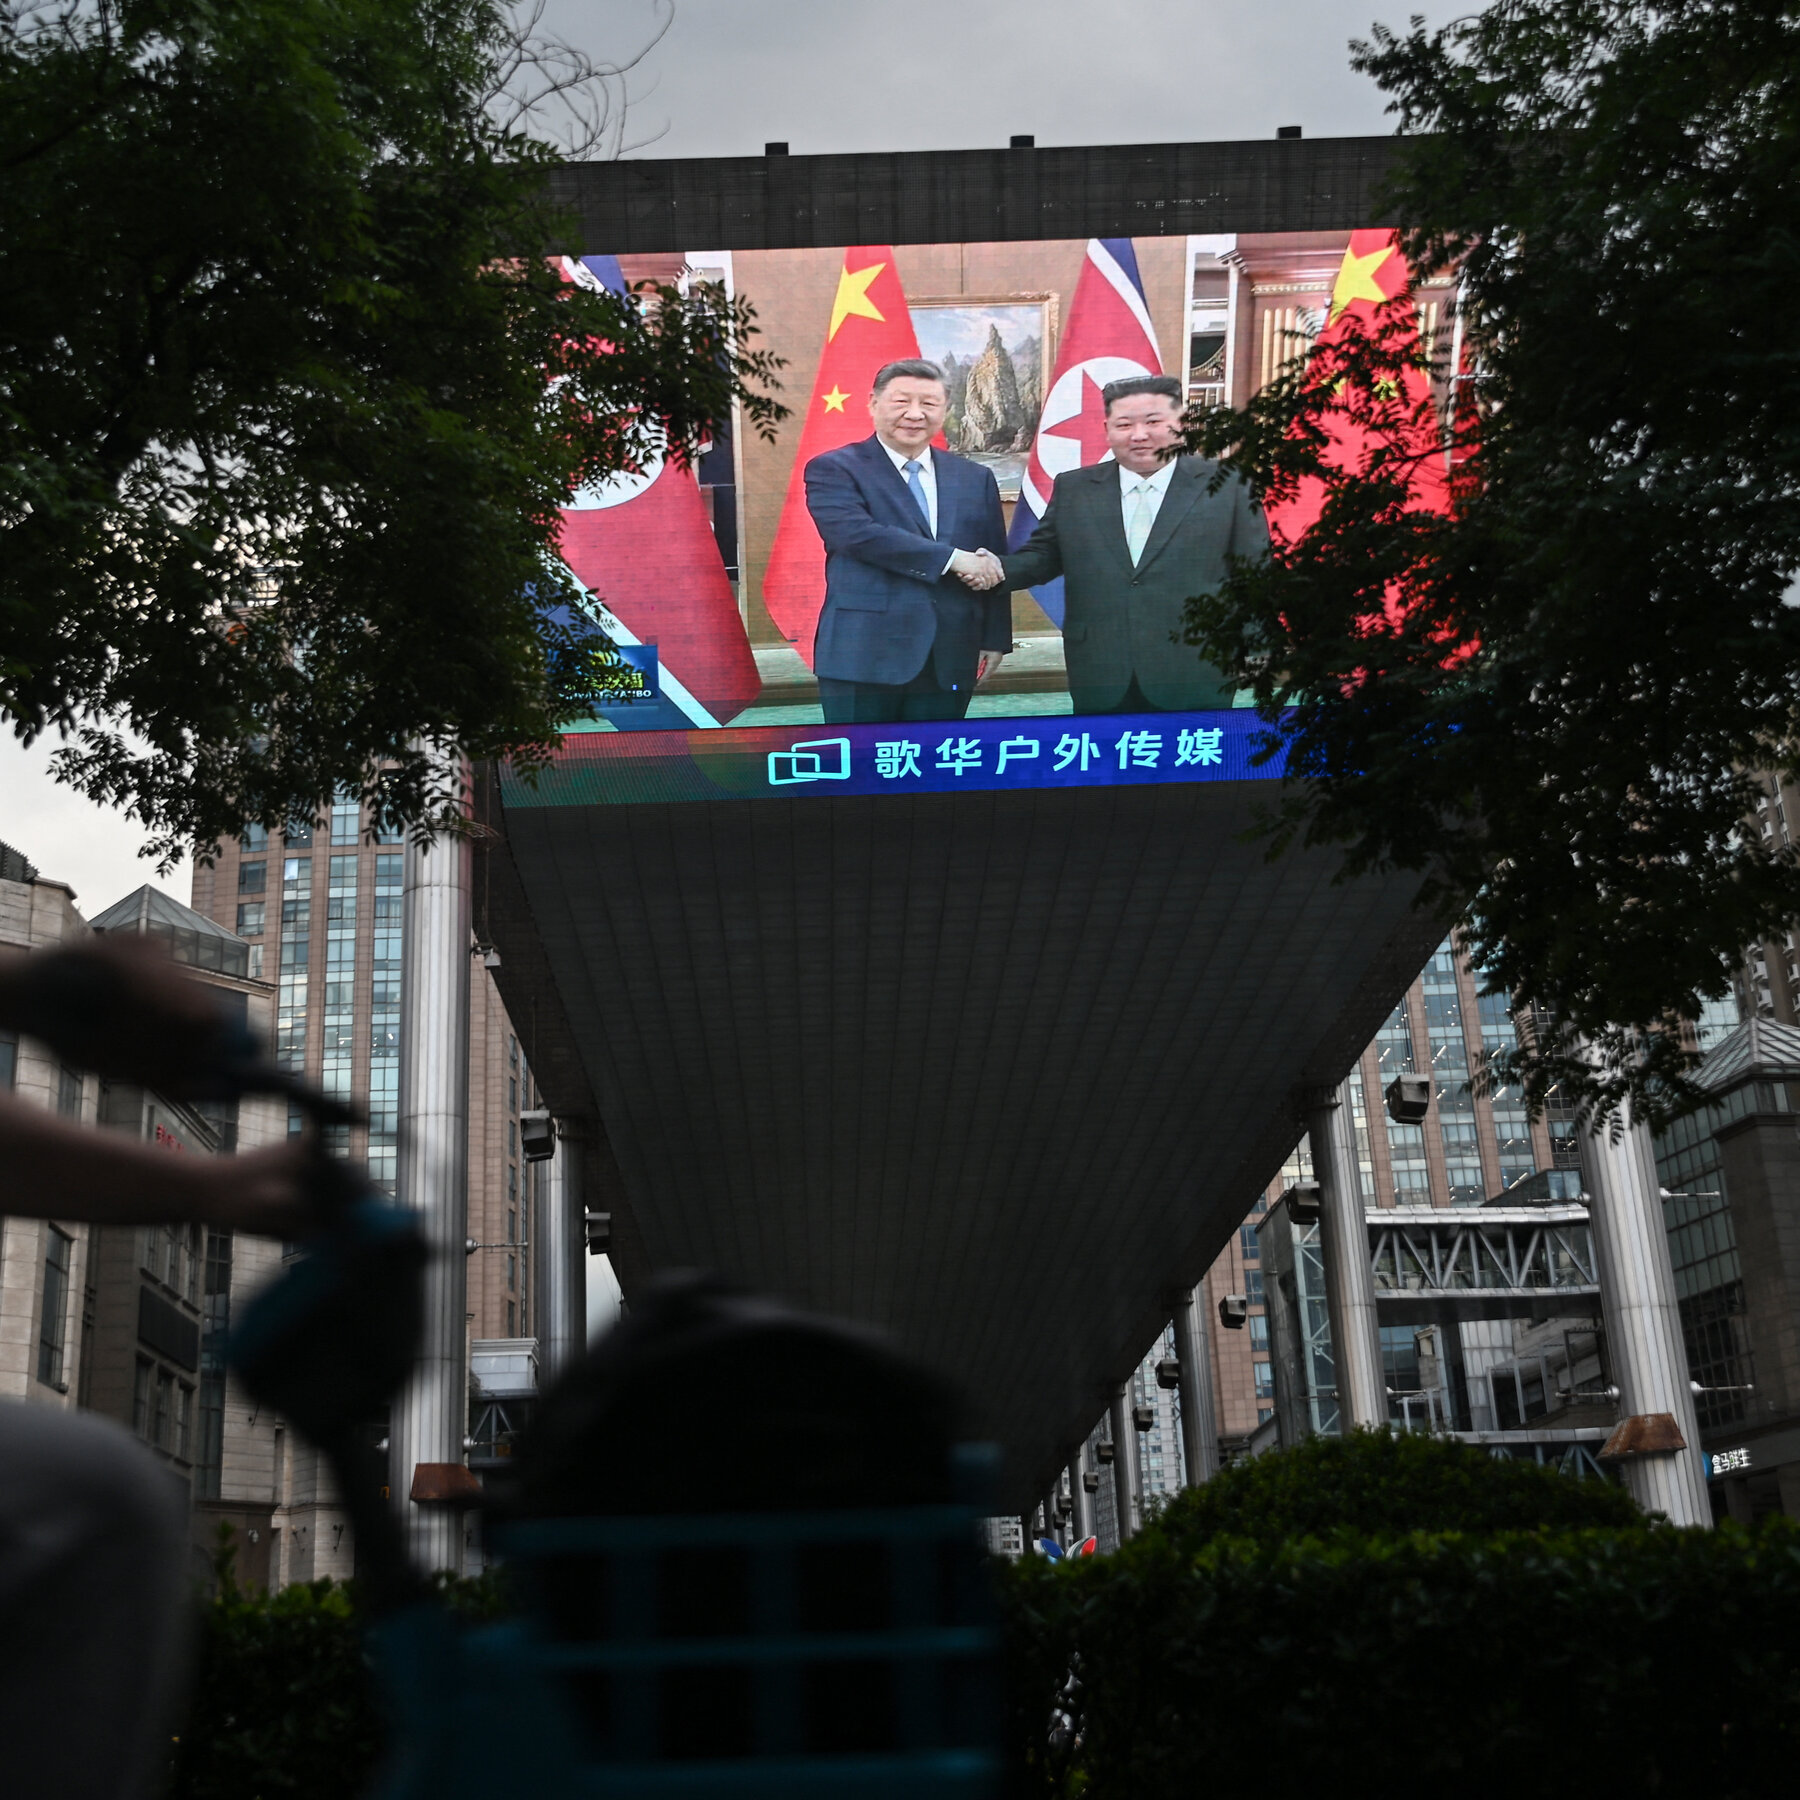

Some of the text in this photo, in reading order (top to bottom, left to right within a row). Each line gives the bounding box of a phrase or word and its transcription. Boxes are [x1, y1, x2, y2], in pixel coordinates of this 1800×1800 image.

[875, 728, 1223, 778] 歌华户外传媒
[1712, 1448, 1751, 1474] 盒马鲜生
